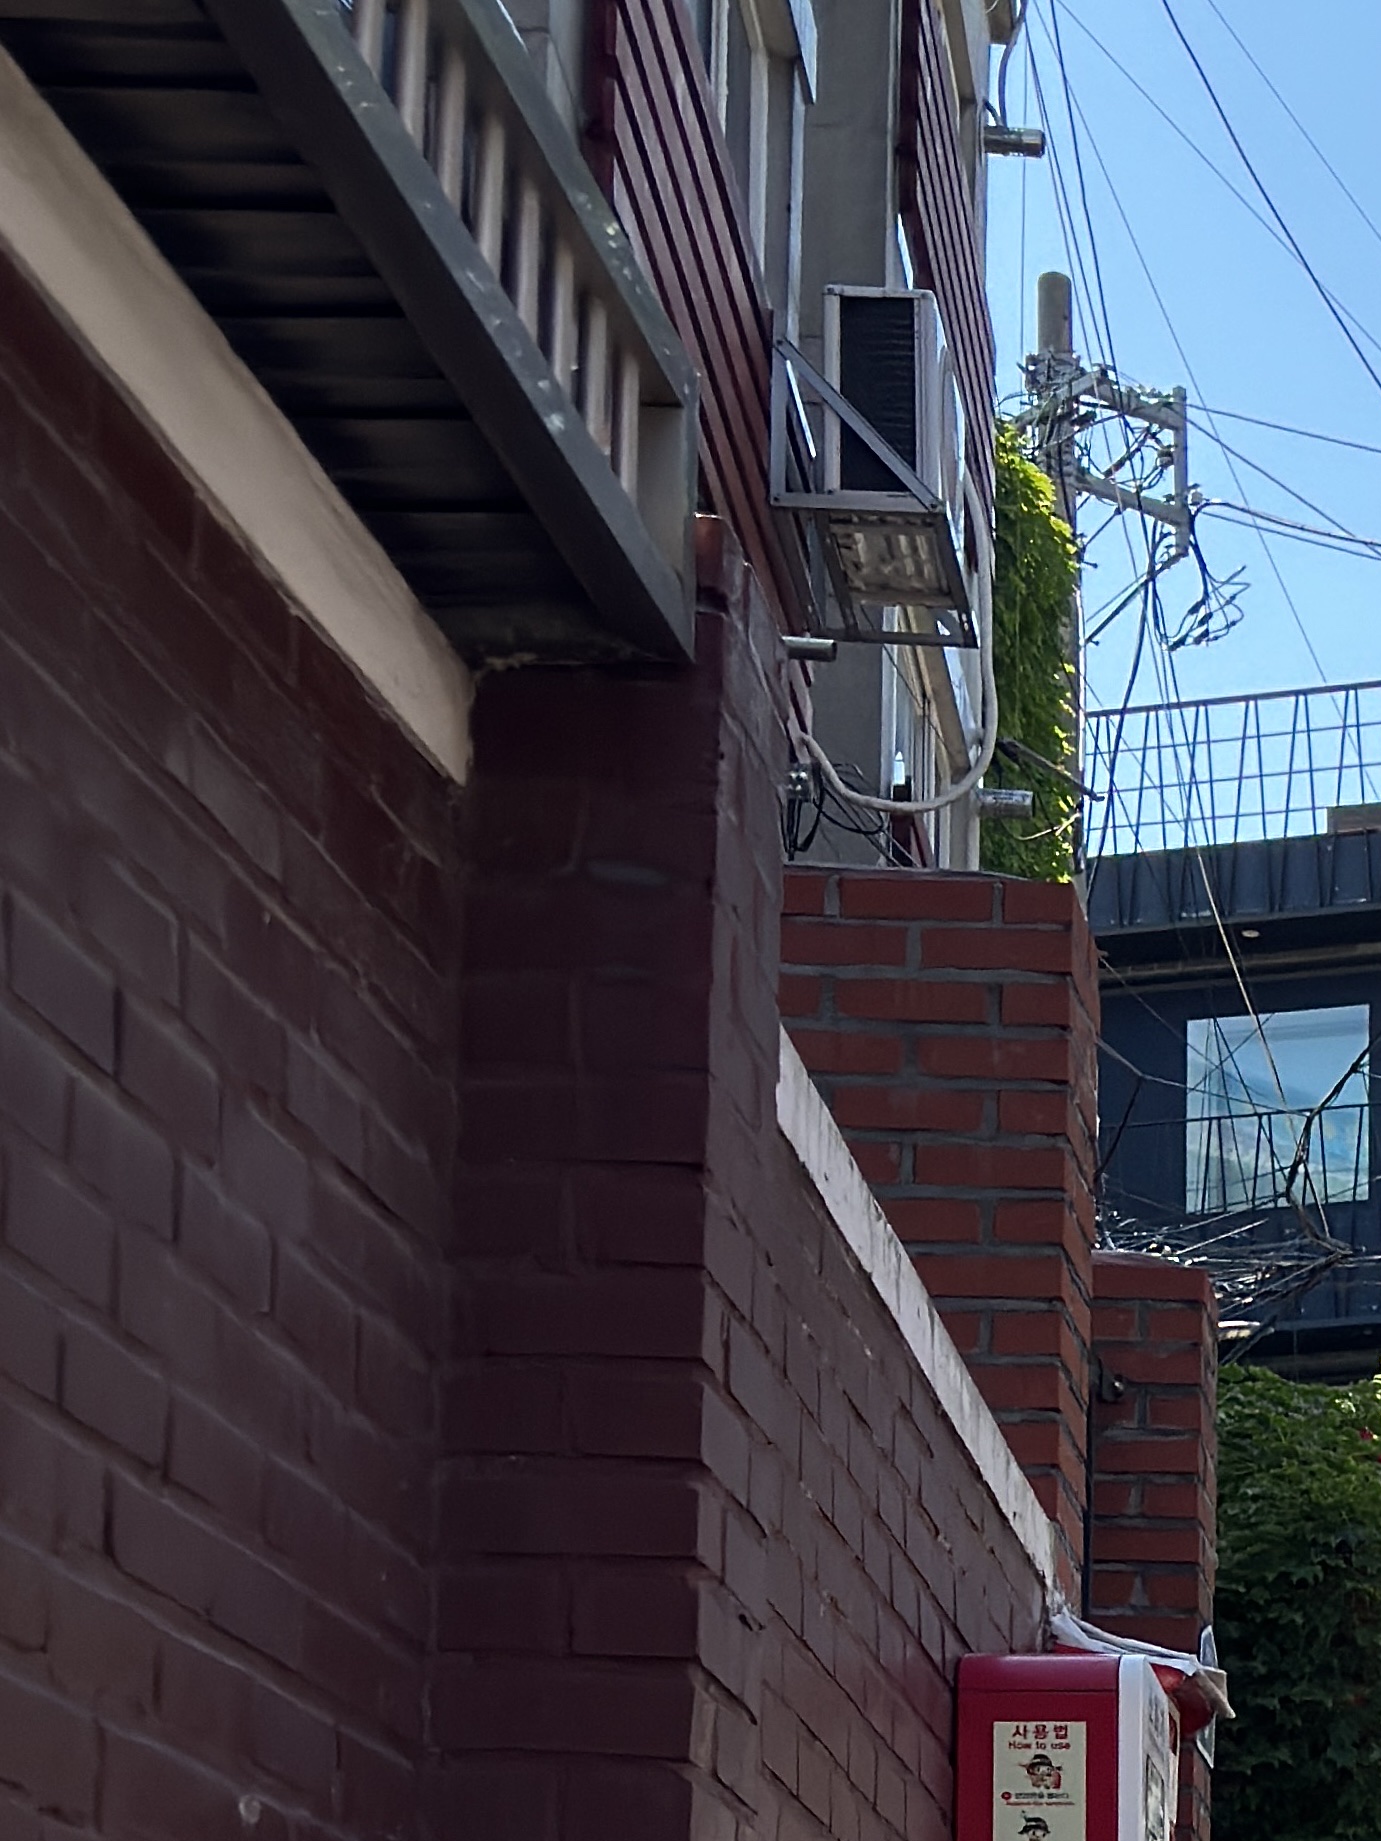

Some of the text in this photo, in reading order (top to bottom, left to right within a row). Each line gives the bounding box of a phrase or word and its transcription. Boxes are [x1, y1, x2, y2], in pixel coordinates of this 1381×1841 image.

[1012, 1724, 1068, 1740] 사용법
[1008, 1741, 1071, 1750] How to use
